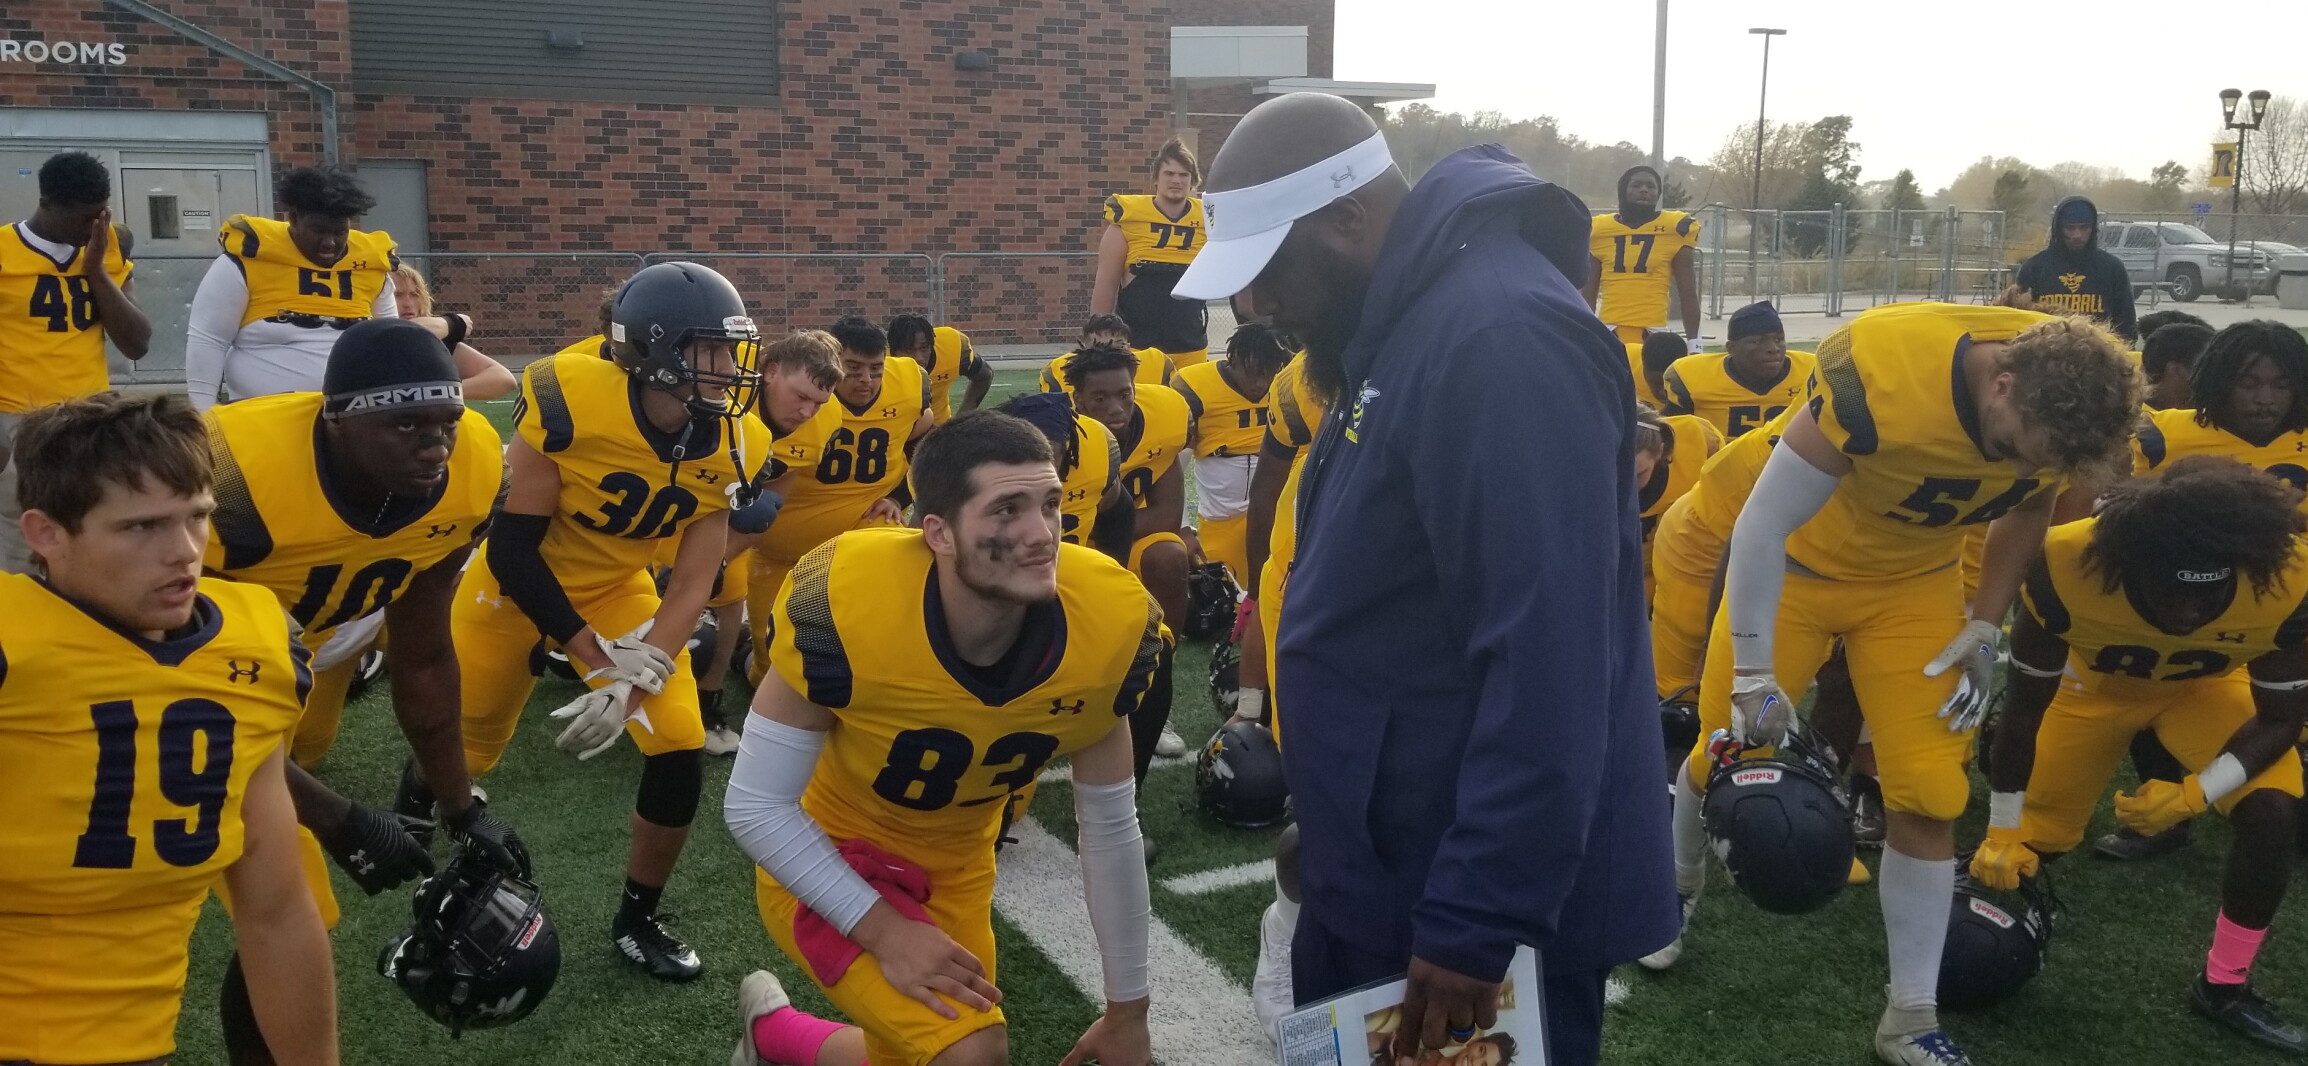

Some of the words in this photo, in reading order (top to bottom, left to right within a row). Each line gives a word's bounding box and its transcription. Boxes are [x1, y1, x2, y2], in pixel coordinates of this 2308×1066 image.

[0, 39, 127, 65] ROOMS
[1150, 223, 1195, 250] 77
[1613, 234, 1655, 273] 17
[30, 275, 98, 332] 48
[298, 267, 353, 300] 51
[815, 427, 889, 484] 68
[571, 472, 698, 539] 30
[289, 558, 413, 634] 10
[73, 698, 237, 869] 19
[872, 727, 1060, 811] 83
[1737, 772, 1775, 783] Riddell
[1975, 903, 2009, 925] Riddell
